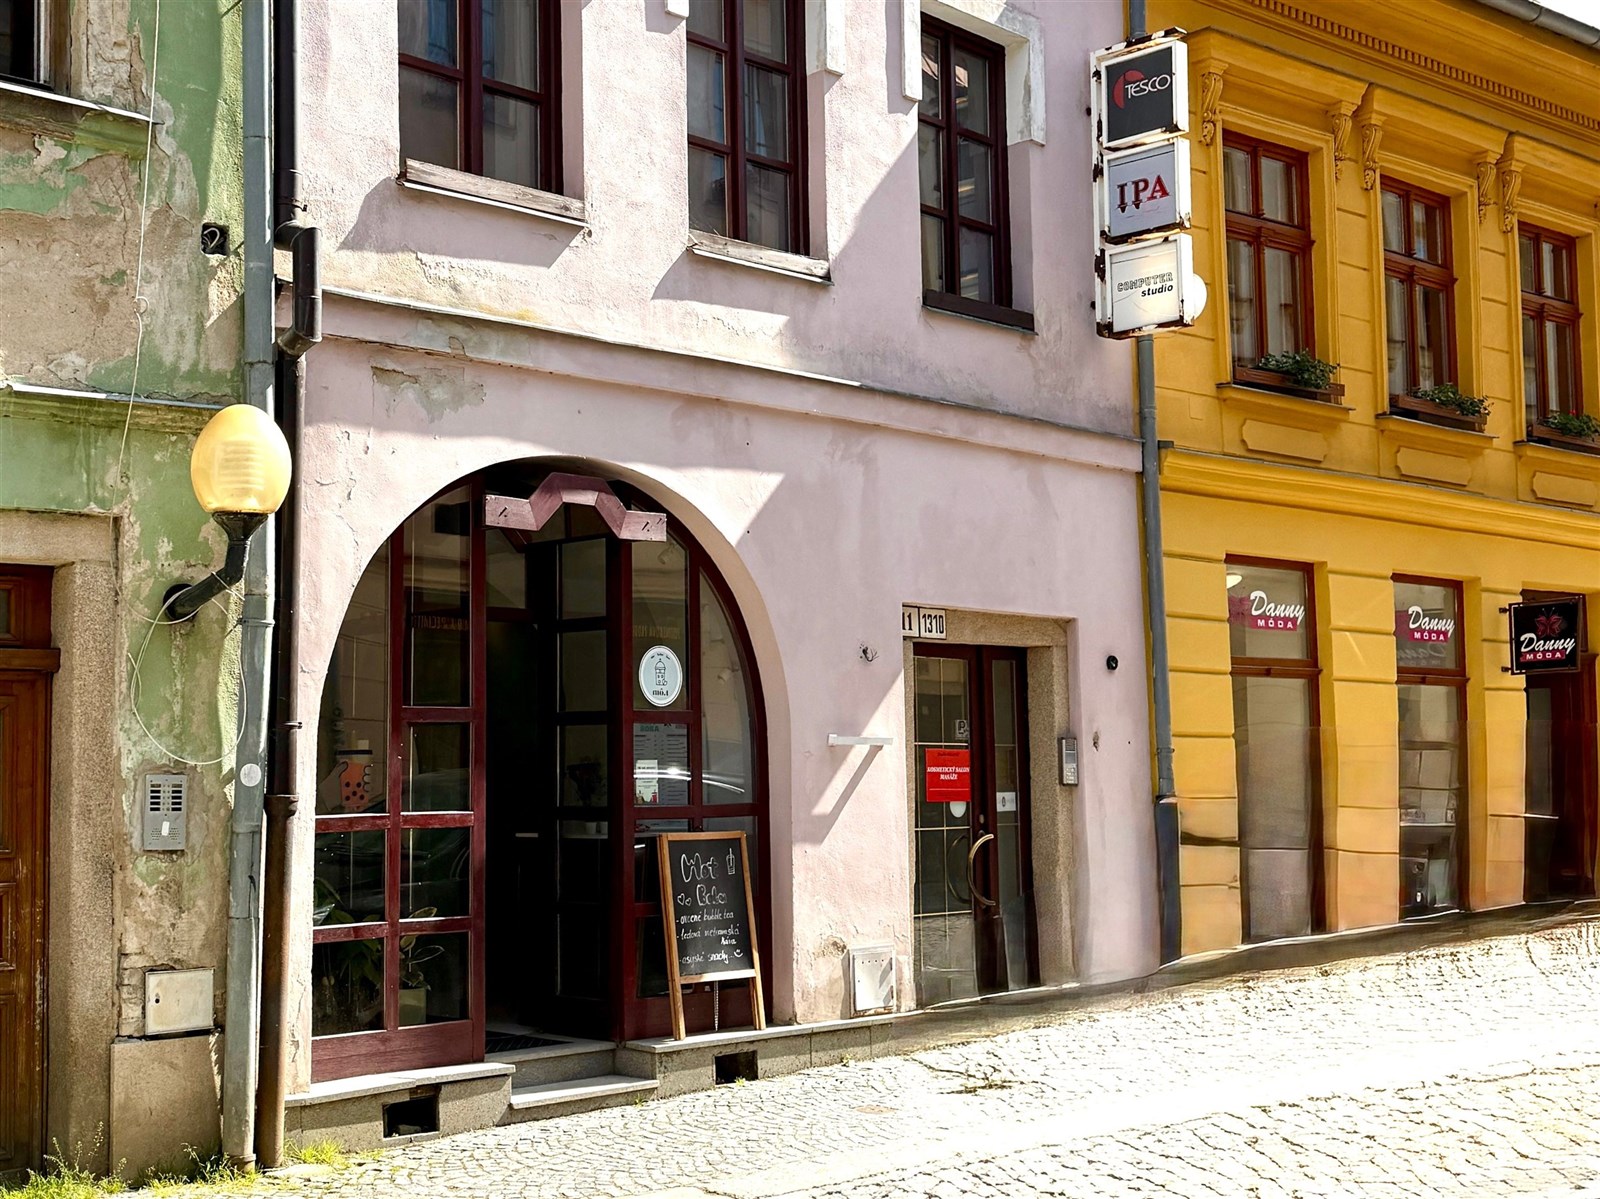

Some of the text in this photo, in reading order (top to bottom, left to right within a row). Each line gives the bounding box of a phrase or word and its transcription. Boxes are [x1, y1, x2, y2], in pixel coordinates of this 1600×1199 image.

[1125, 74, 1171, 99] TESCO
[1116, 174, 1170, 213] IPA
[1116, 271, 1174, 293] COMPUTER
[1141, 283, 1174, 298] studio
[1249, 590, 1305, 626] Danny
[922, 613, 945, 634] 1310
[1257, 618, 1294, 629] MÓDA
[1408, 605, 1456, 639] Danny
[1413, 630, 1445, 641] MÓDA
[1520, 632, 1576, 655] Danny
[1525, 651, 1562, 660] MÓDA
[723, 910, 734, 920] tea
